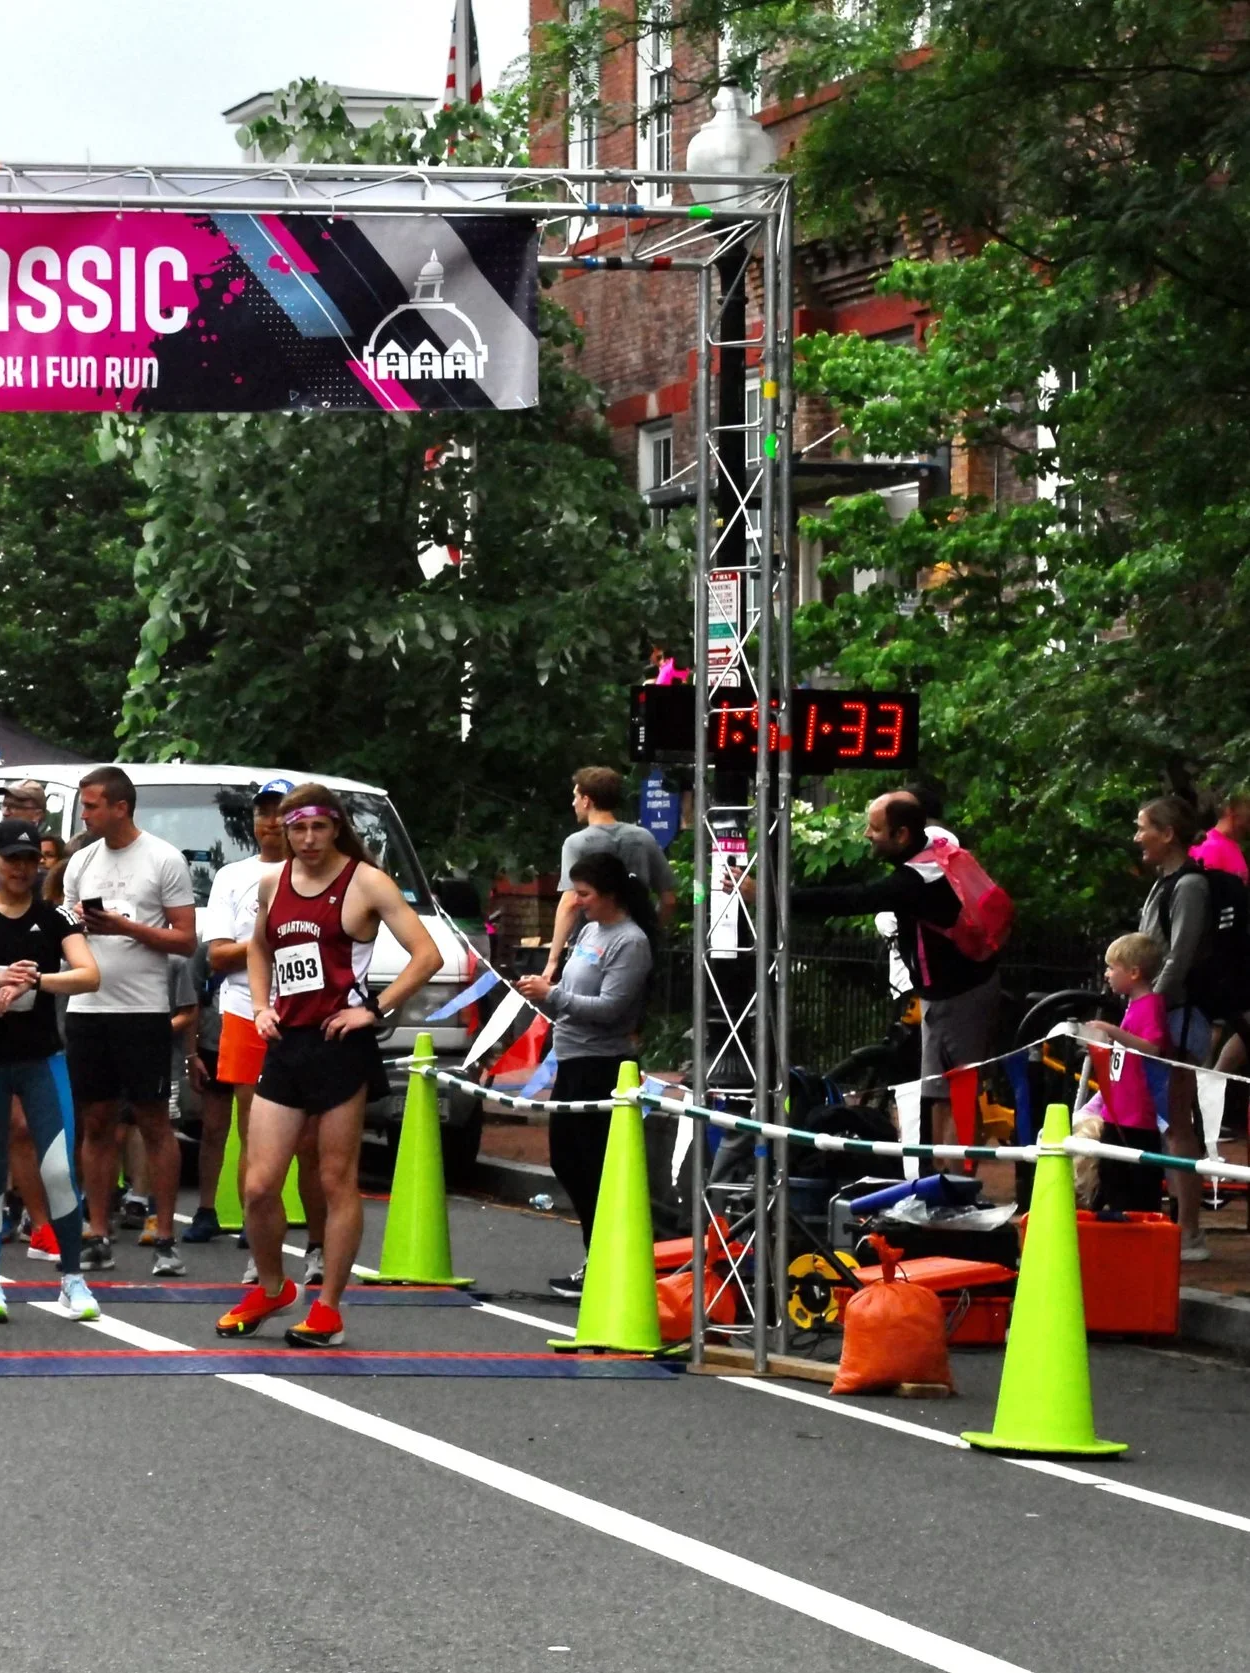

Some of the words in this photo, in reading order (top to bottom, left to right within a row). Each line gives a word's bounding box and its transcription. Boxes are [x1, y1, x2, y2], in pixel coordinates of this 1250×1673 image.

[46, 356, 98, 388] FUN
[105, 357, 160, 389] RUN
[278, 958, 318, 985] 2493
